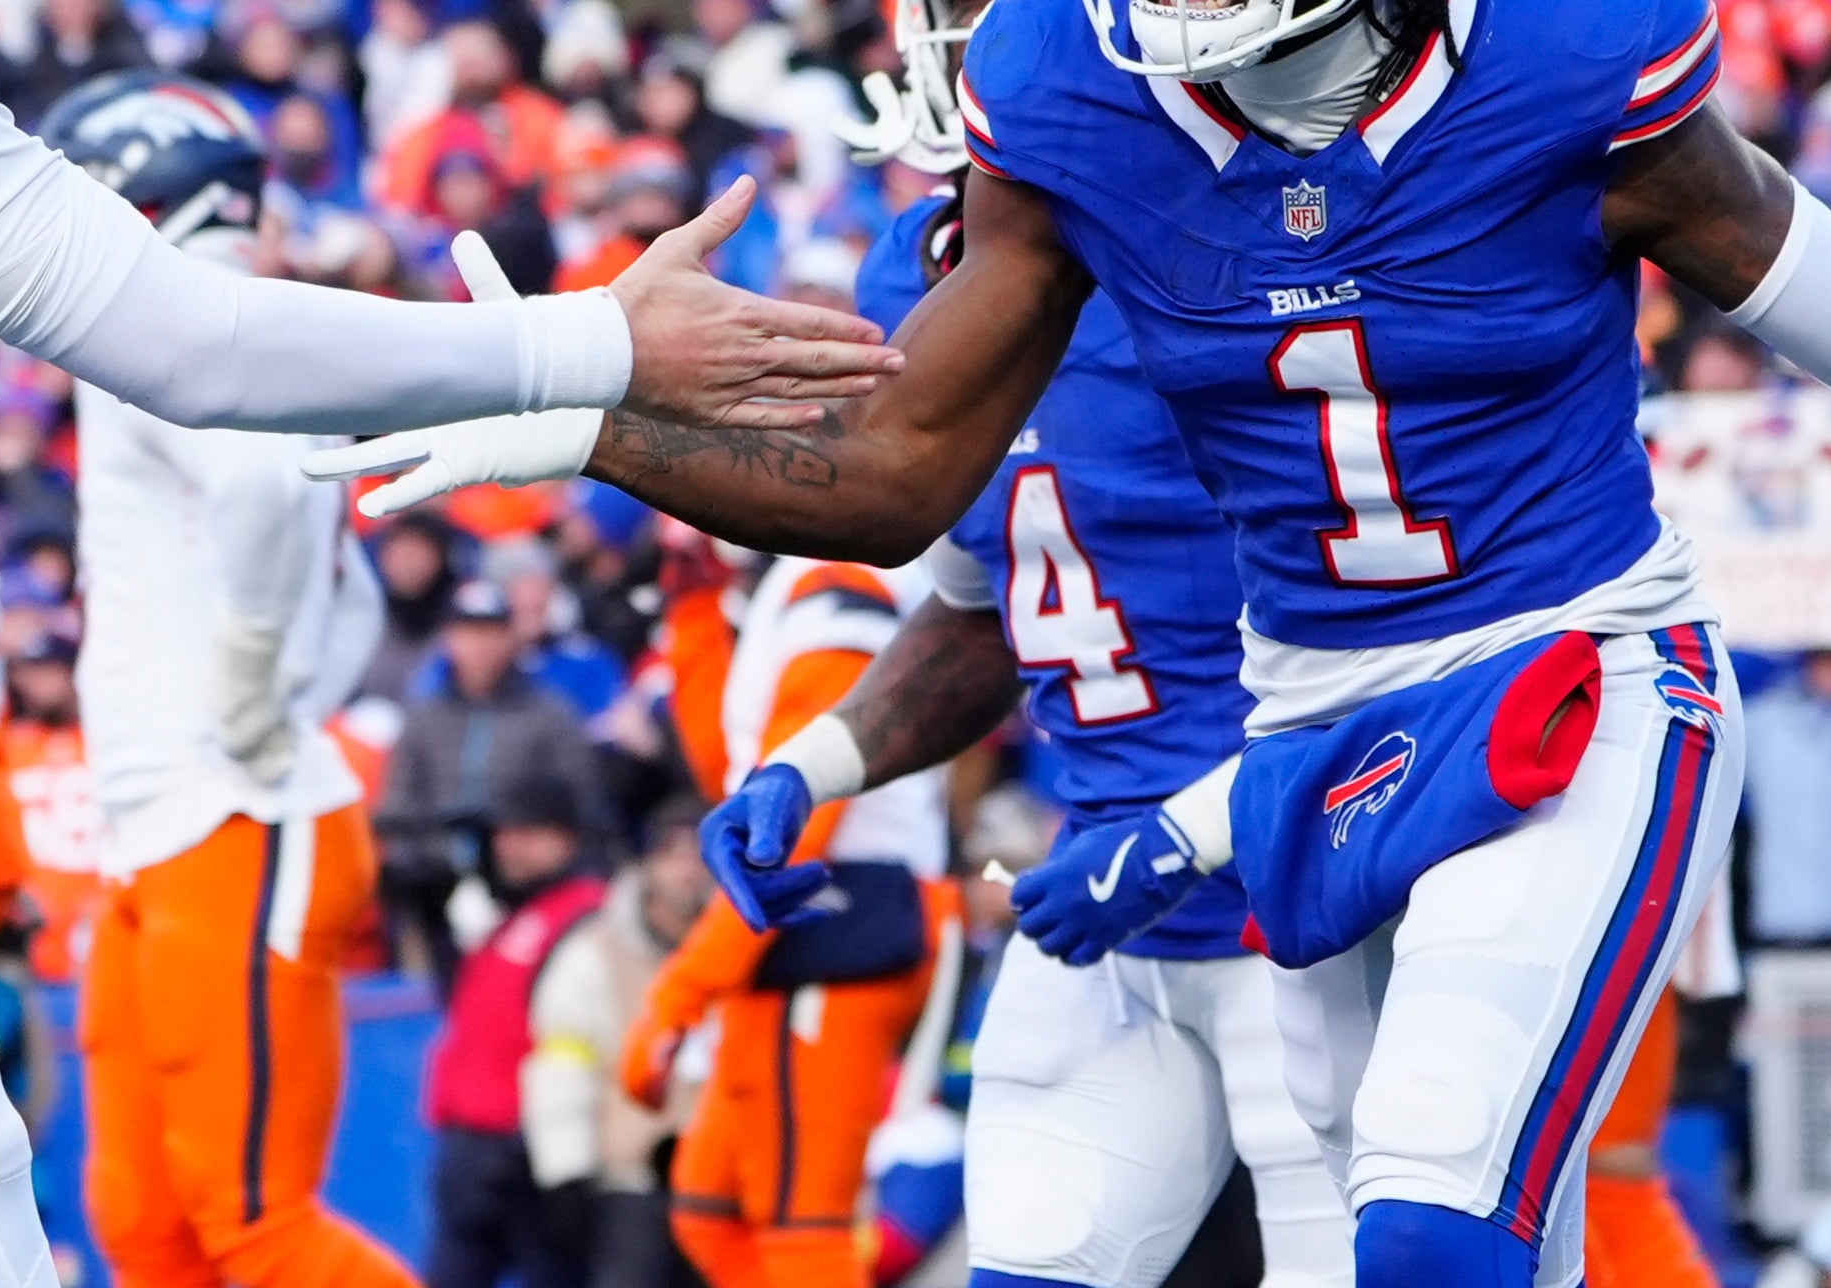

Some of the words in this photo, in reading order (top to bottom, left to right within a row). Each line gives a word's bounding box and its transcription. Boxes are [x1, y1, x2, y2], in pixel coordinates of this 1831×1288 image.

[1290, 208, 1320, 229] NFL
[1266, 279, 1362, 317] BILLS
[1265, 315, 1466, 590] 1
[1005, 464, 1160, 727] 4
